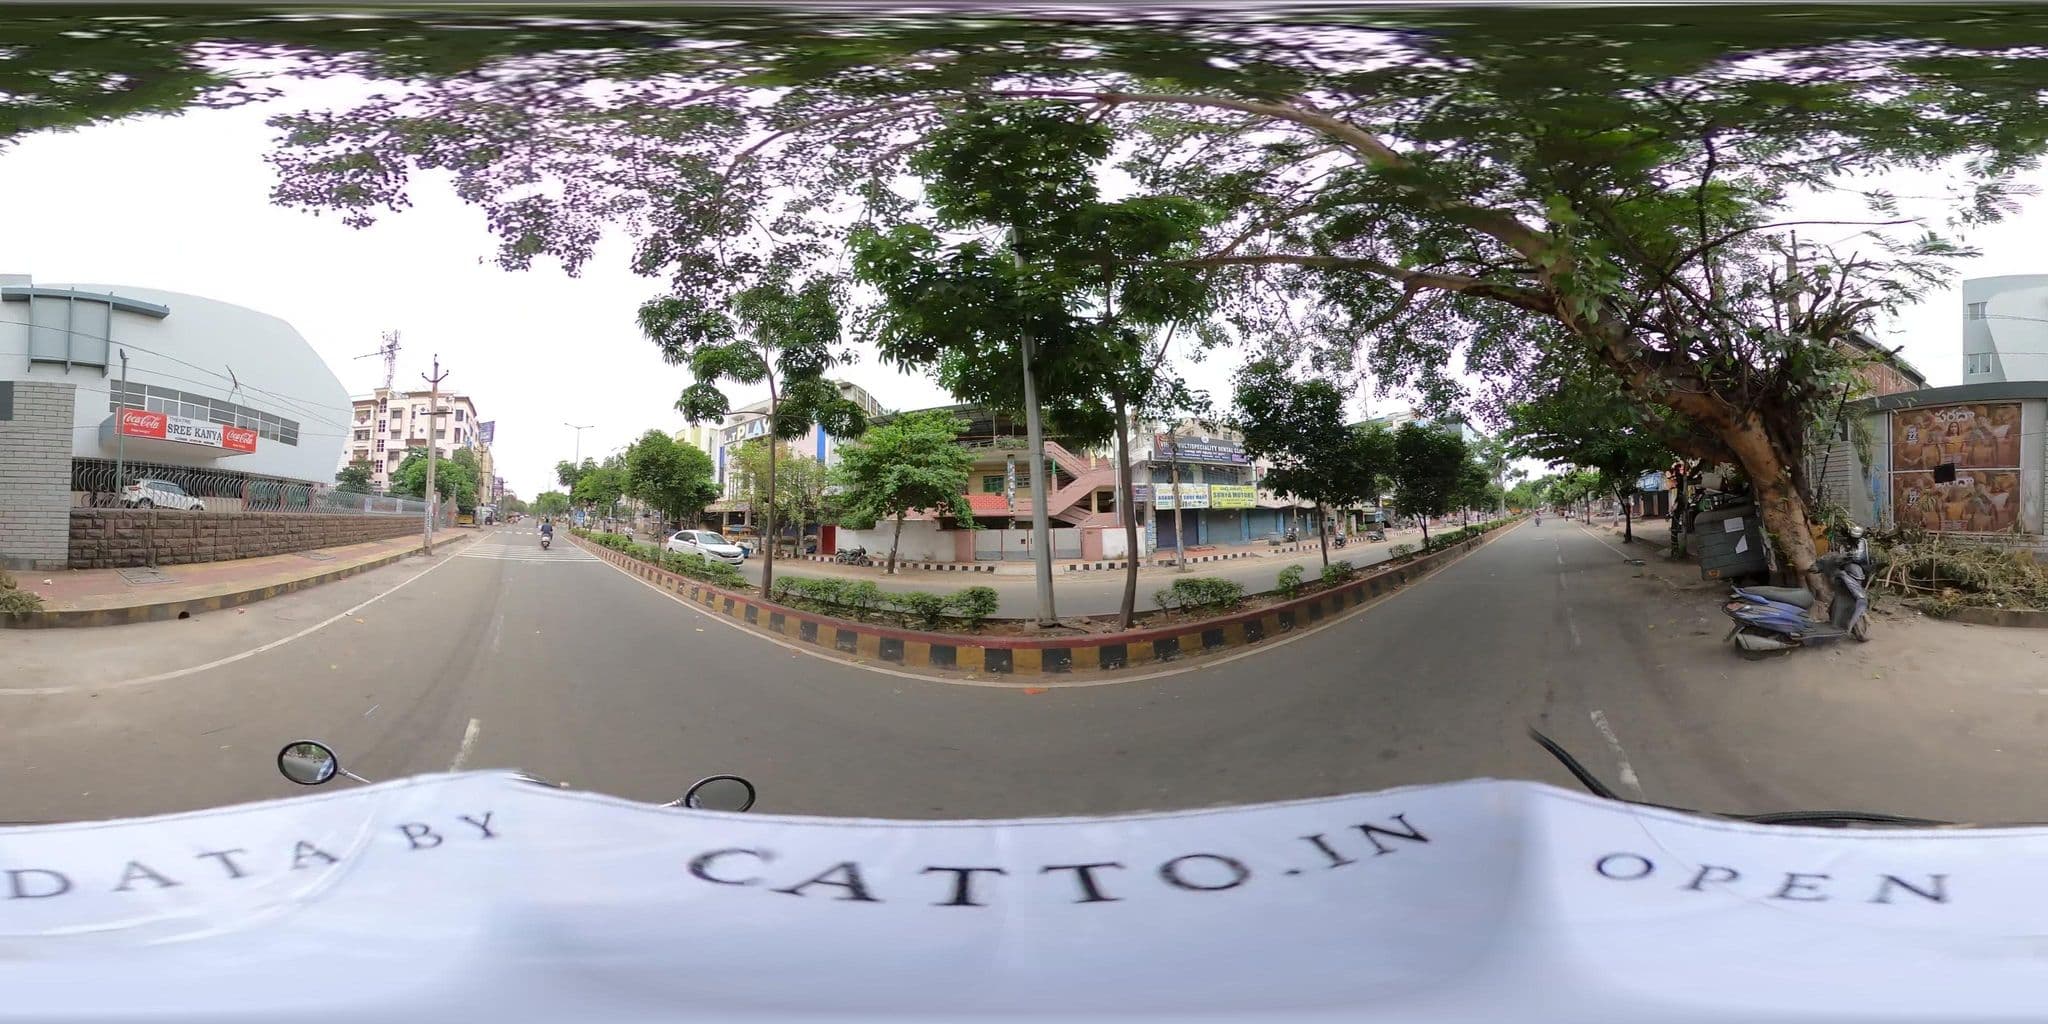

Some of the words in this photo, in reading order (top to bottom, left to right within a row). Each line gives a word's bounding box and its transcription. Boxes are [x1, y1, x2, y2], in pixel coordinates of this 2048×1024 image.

[167, 423, 192, 437] SREE
[194, 427, 222, 441] KANYA
[4, 837, 341, 900] DATA
[399, 810, 502, 852] BY
[688, 813, 1432, 907] CATTO.IN
[1593, 852, 1952, 905] OPEN
